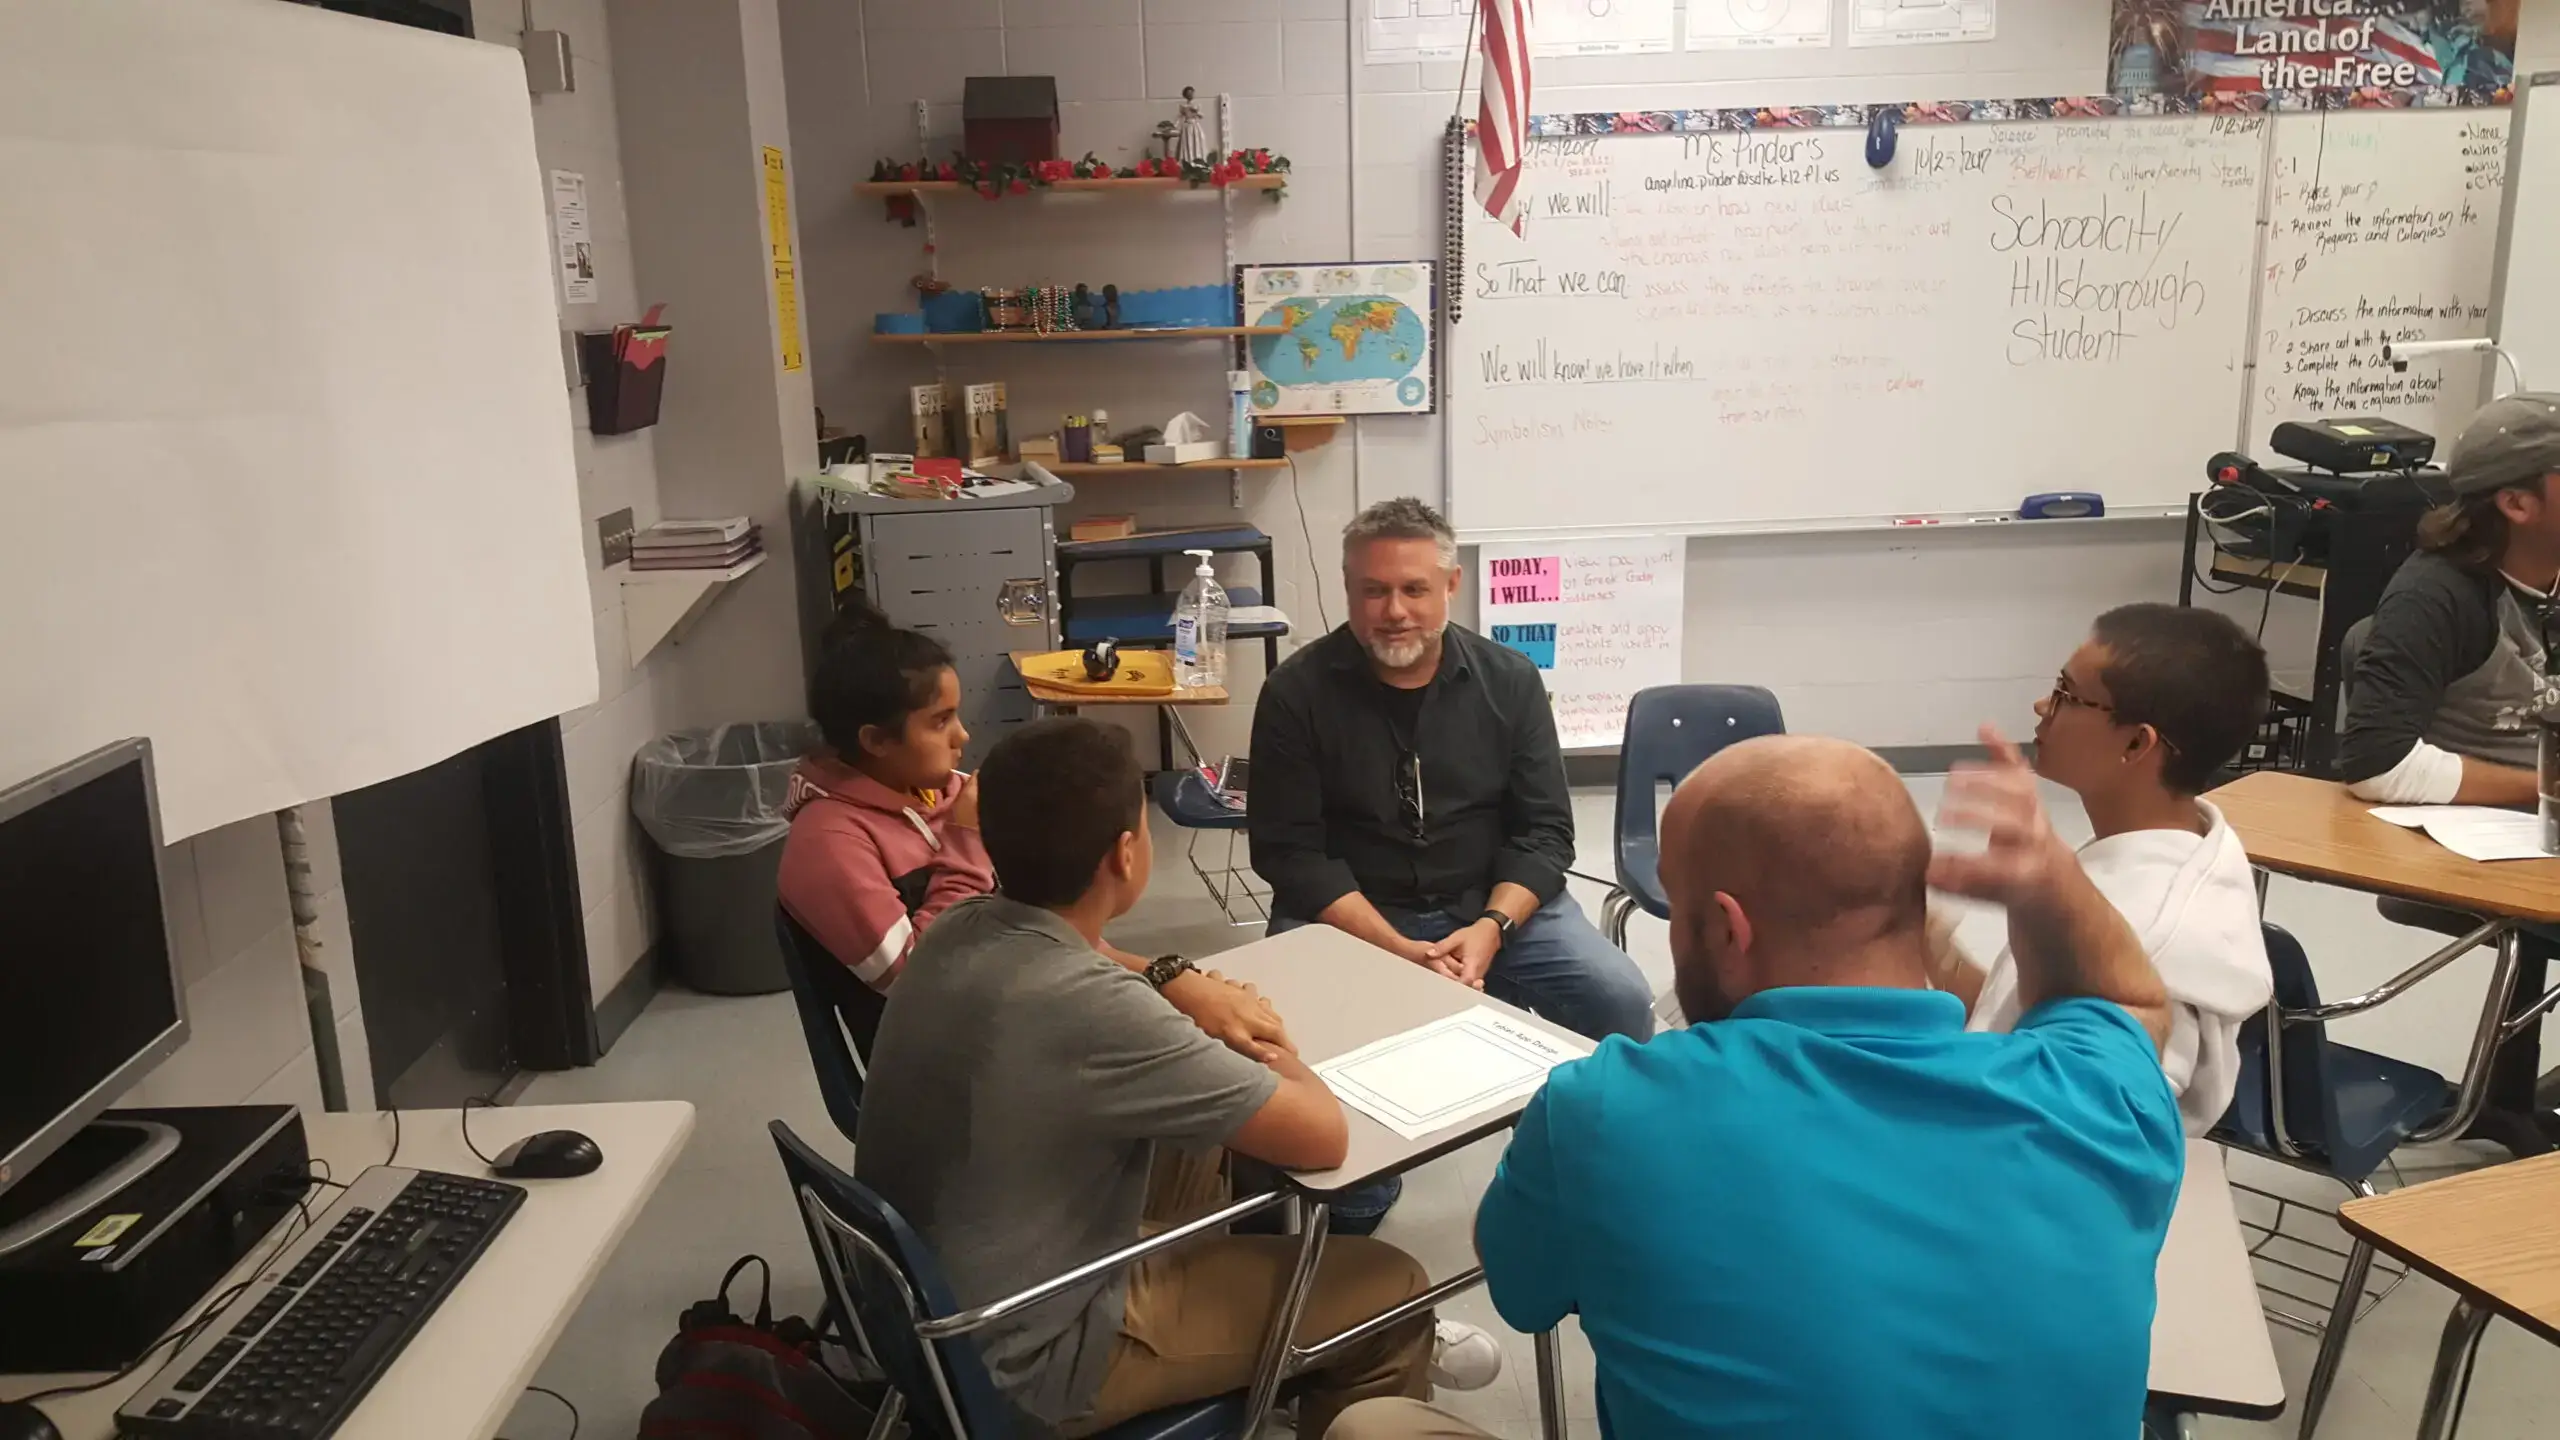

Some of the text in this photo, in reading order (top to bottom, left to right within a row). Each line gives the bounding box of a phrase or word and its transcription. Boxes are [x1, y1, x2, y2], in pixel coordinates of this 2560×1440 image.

[2234, 16, 2376, 56] Land of
[2260, 56, 2417, 90] the Free
[1732, 130, 1825, 170] Pinder's
[1548, 192, 1572, 217] We
[2346, 211, 2361, 228] the
[2459, 196, 2478, 227] the
[2364, 229, 2389, 242] and
[1476, 261, 1500, 298] So
[2010, 256, 2205, 330] Hillsborough
[2296, 306, 2347, 326] Discuss
[2355, 294, 2375, 320] the
[2377, 293, 2434, 320] information
[2439, 293, 2463, 319] with
[2006, 309, 2139, 367] Student
[2354, 328, 2374, 348] with
[1480, 344, 1511, 383] We
[1517, 336, 1547, 381] will
[2297, 354, 2339, 377] Complete
[2348, 352, 2362, 369] the
[2292, 367, 2445, 402] Know the information about
[2307, 397, 2324, 412] the
[1489, 558, 1548, 578] TODAY,
[1490, 586, 1560, 605] I WILL...
[1491, 624, 1557, 643] SO THAT
